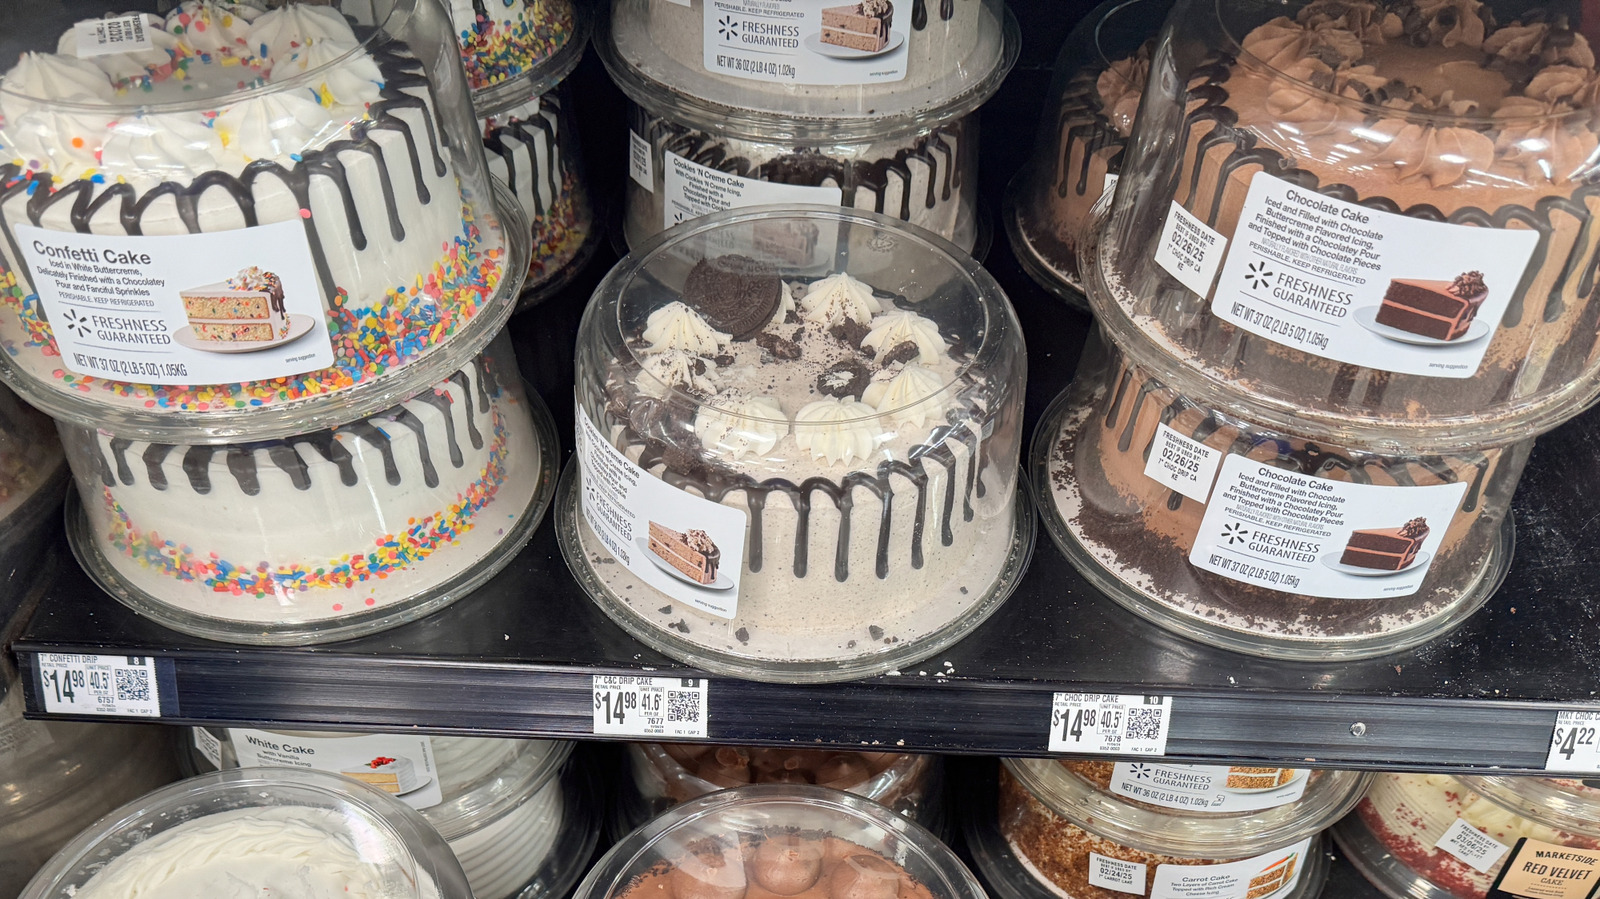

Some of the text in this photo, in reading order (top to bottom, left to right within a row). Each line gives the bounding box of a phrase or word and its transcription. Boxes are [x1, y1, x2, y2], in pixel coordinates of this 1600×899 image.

[742, 21, 799, 37] FRESHNESS
[742, 34, 798, 48] GUARANTEED
[717, 55, 795, 79] NET WT 36 OZ (2 LB 4 OZ) 1.02kg
[674, 158, 696, 173] Cookies
[704, 171, 726, 183] Creme
[727, 178, 745, 188] Cake
[683, 186, 707, 200] Chocolatey
[689, 182, 708, 193] Finished
[1286, 190, 1370, 224] Chocolate Cake
[1174, 211, 1215, 245] FRESHNESS DATE
[1265, 196, 1383, 241] Iced and Filled with Chocolate
[1266, 207, 1374, 250] Buttercreme Flavored Icing,
[1172, 231, 1204, 262] 02/26/25
[1248, 222, 1381, 271] and Topped with Chocolate Pieces
[1256, 213, 1287, 232] Finished
[1288, 228, 1304, 239] with
[1312, 235, 1358, 256] Chocolatey
[1359, 249, 1380, 260] Pour
[33, 240, 151, 265] Confetti Cake
[37, 266, 68, 280] Delicately
[69, 272, 98, 283] Finished
[99, 276, 114, 285] with
[122, 278, 165, 287] Chocolatey
[49, 258, 142, 276] Iced in White Buttercreme,
[56, 280, 150, 297] Pour and Fanciful Sprinkles
[1277, 272, 1353, 305] FRESHNESS
[1273, 287, 1347, 317] GUARANTEED
[92, 316, 167, 332] FRESHNESS
[1231, 301, 1329, 350] NET WT 37 OZ (2 LB 5 OZ) 1.05kg
[97, 330, 170, 345] GUARANTEED
[73, 352, 188, 379] NET WT 37 OZ (2 LB 5 OZ) 1.05KG
[1163, 430, 1209, 458] FRESHNESS DATE
[624, 462, 639, 479] Cake
[1162, 448, 1199, 472] 02/26/25
[1238, 472, 1345, 504] Iced and Filled with Chocolate
[1258, 467, 1333, 492] Chocolate Cake
[1240, 481, 1337, 511] Buttercreme Flavored Icing,
[596, 502, 632, 541] GUARANTEED
[597, 492, 632, 532] FRESHNESS
[1248, 542, 1316, 563] GUARANTEED
[1252, 531, 1320, 553] FRESHNESS
[50, 654, 80, 663] CONFETTI
[134, 657, 140, 665] 8
[636, 678, 652, 686] CAKE
[1102, 695, 1119, 703] CAKE
[1149, 696, 1159, 704] 10
[1559, 711, 1593, 720] MKT CHOC
[245, 734, 315, 755] White Cake
[257, 753, 293, 764] Buttercreme
[1153, 777, 1209, 790] GUARANTEED
[1155, 769, 1212, 784] FRESHNESS
[1457, 834, 1487, 855] 03/06/25
[1536, 851, 1598, 865] MARKETSIDE
[1100, 867, 1132, 880] 02/24/25
[1522, 861, 1592, 880] RED VELVET
